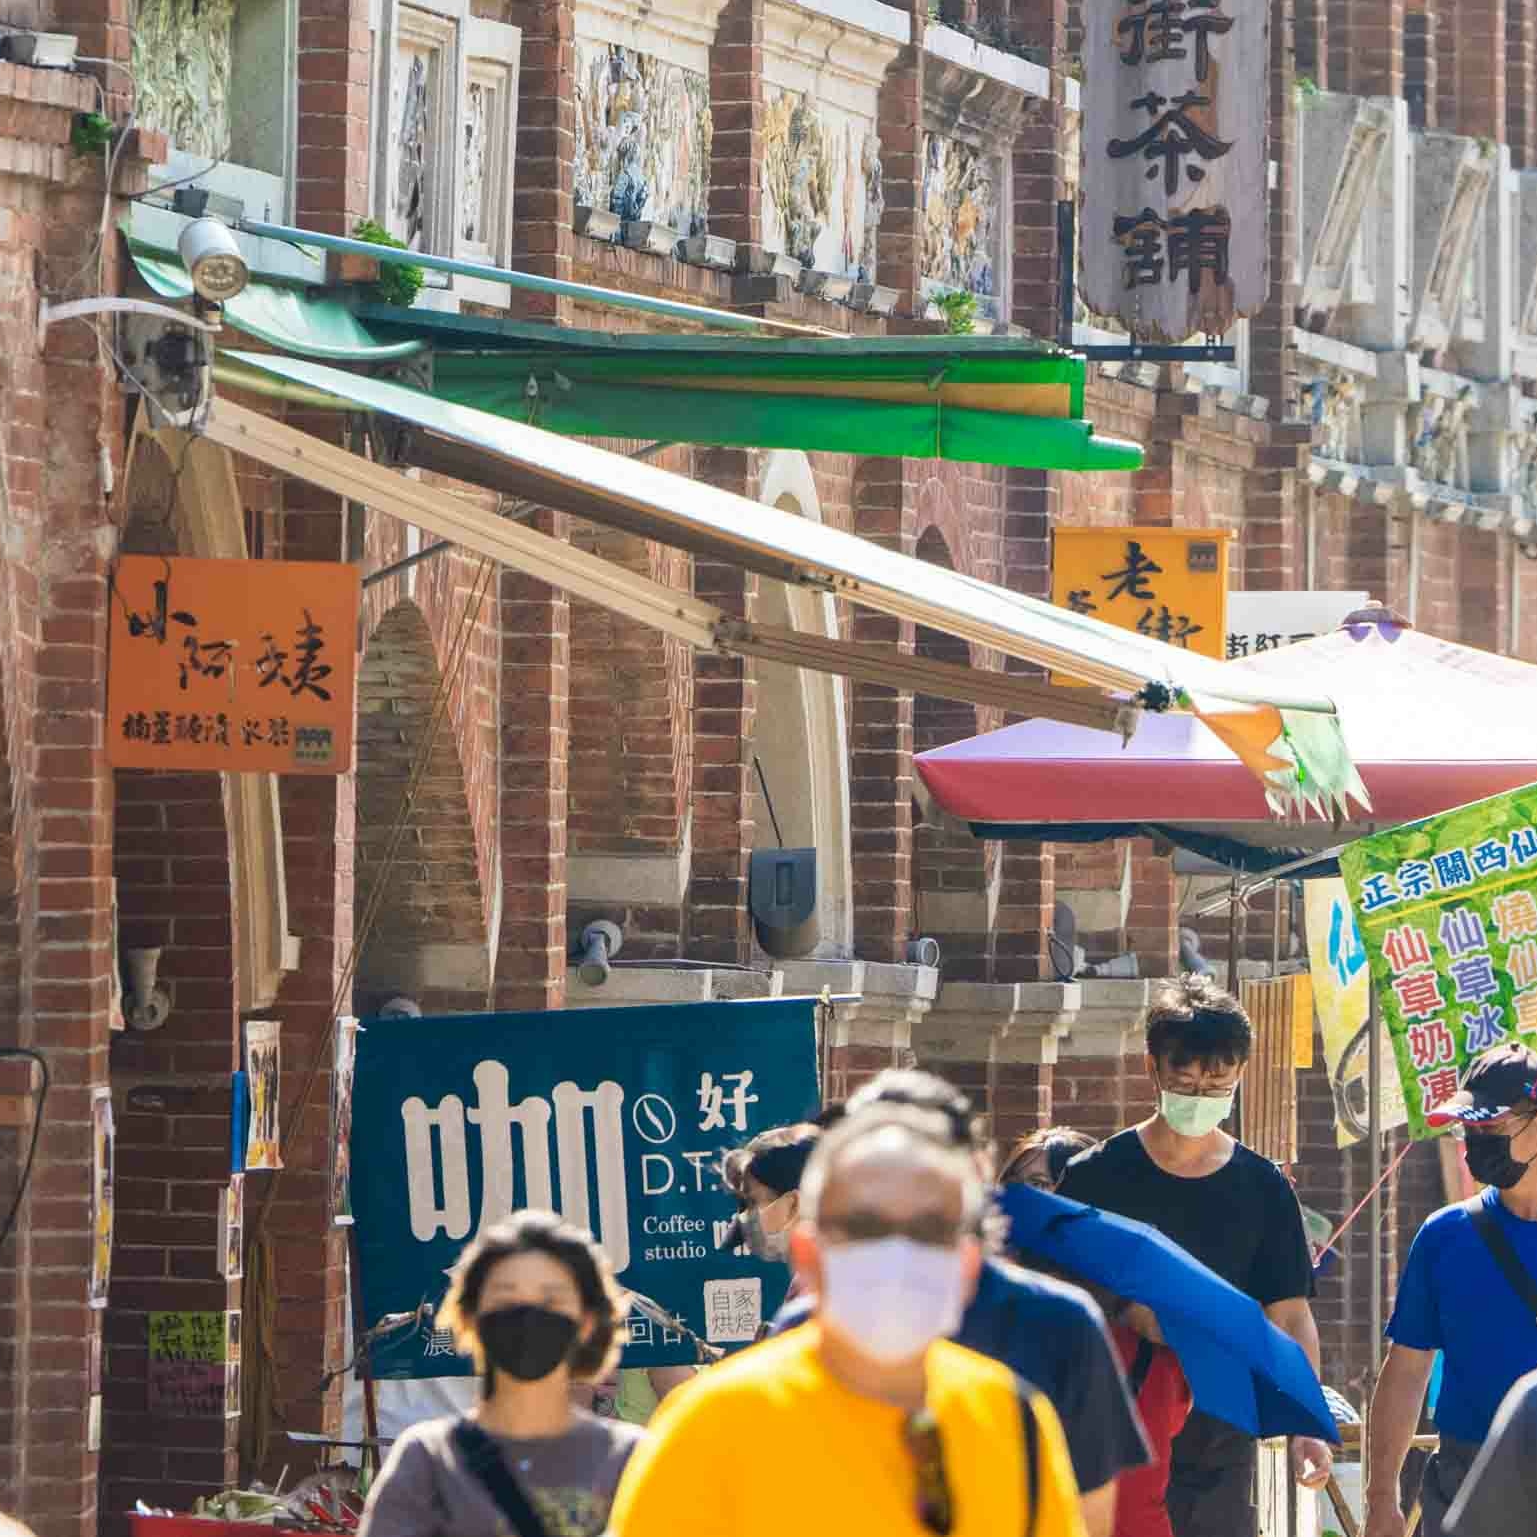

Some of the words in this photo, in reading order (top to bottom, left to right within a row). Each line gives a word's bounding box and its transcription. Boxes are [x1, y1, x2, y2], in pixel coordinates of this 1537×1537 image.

[1438, 907, 1506, 1052] 仙草冰
[696, 1070, 758, 1131] 好
[643, 1214, 706, 1235] Coffee
[644, 1240, 707, 1261] studio
[712, 1287, 755, 1310] 自家
[711, 1312, 756, 1335] 烘焙
